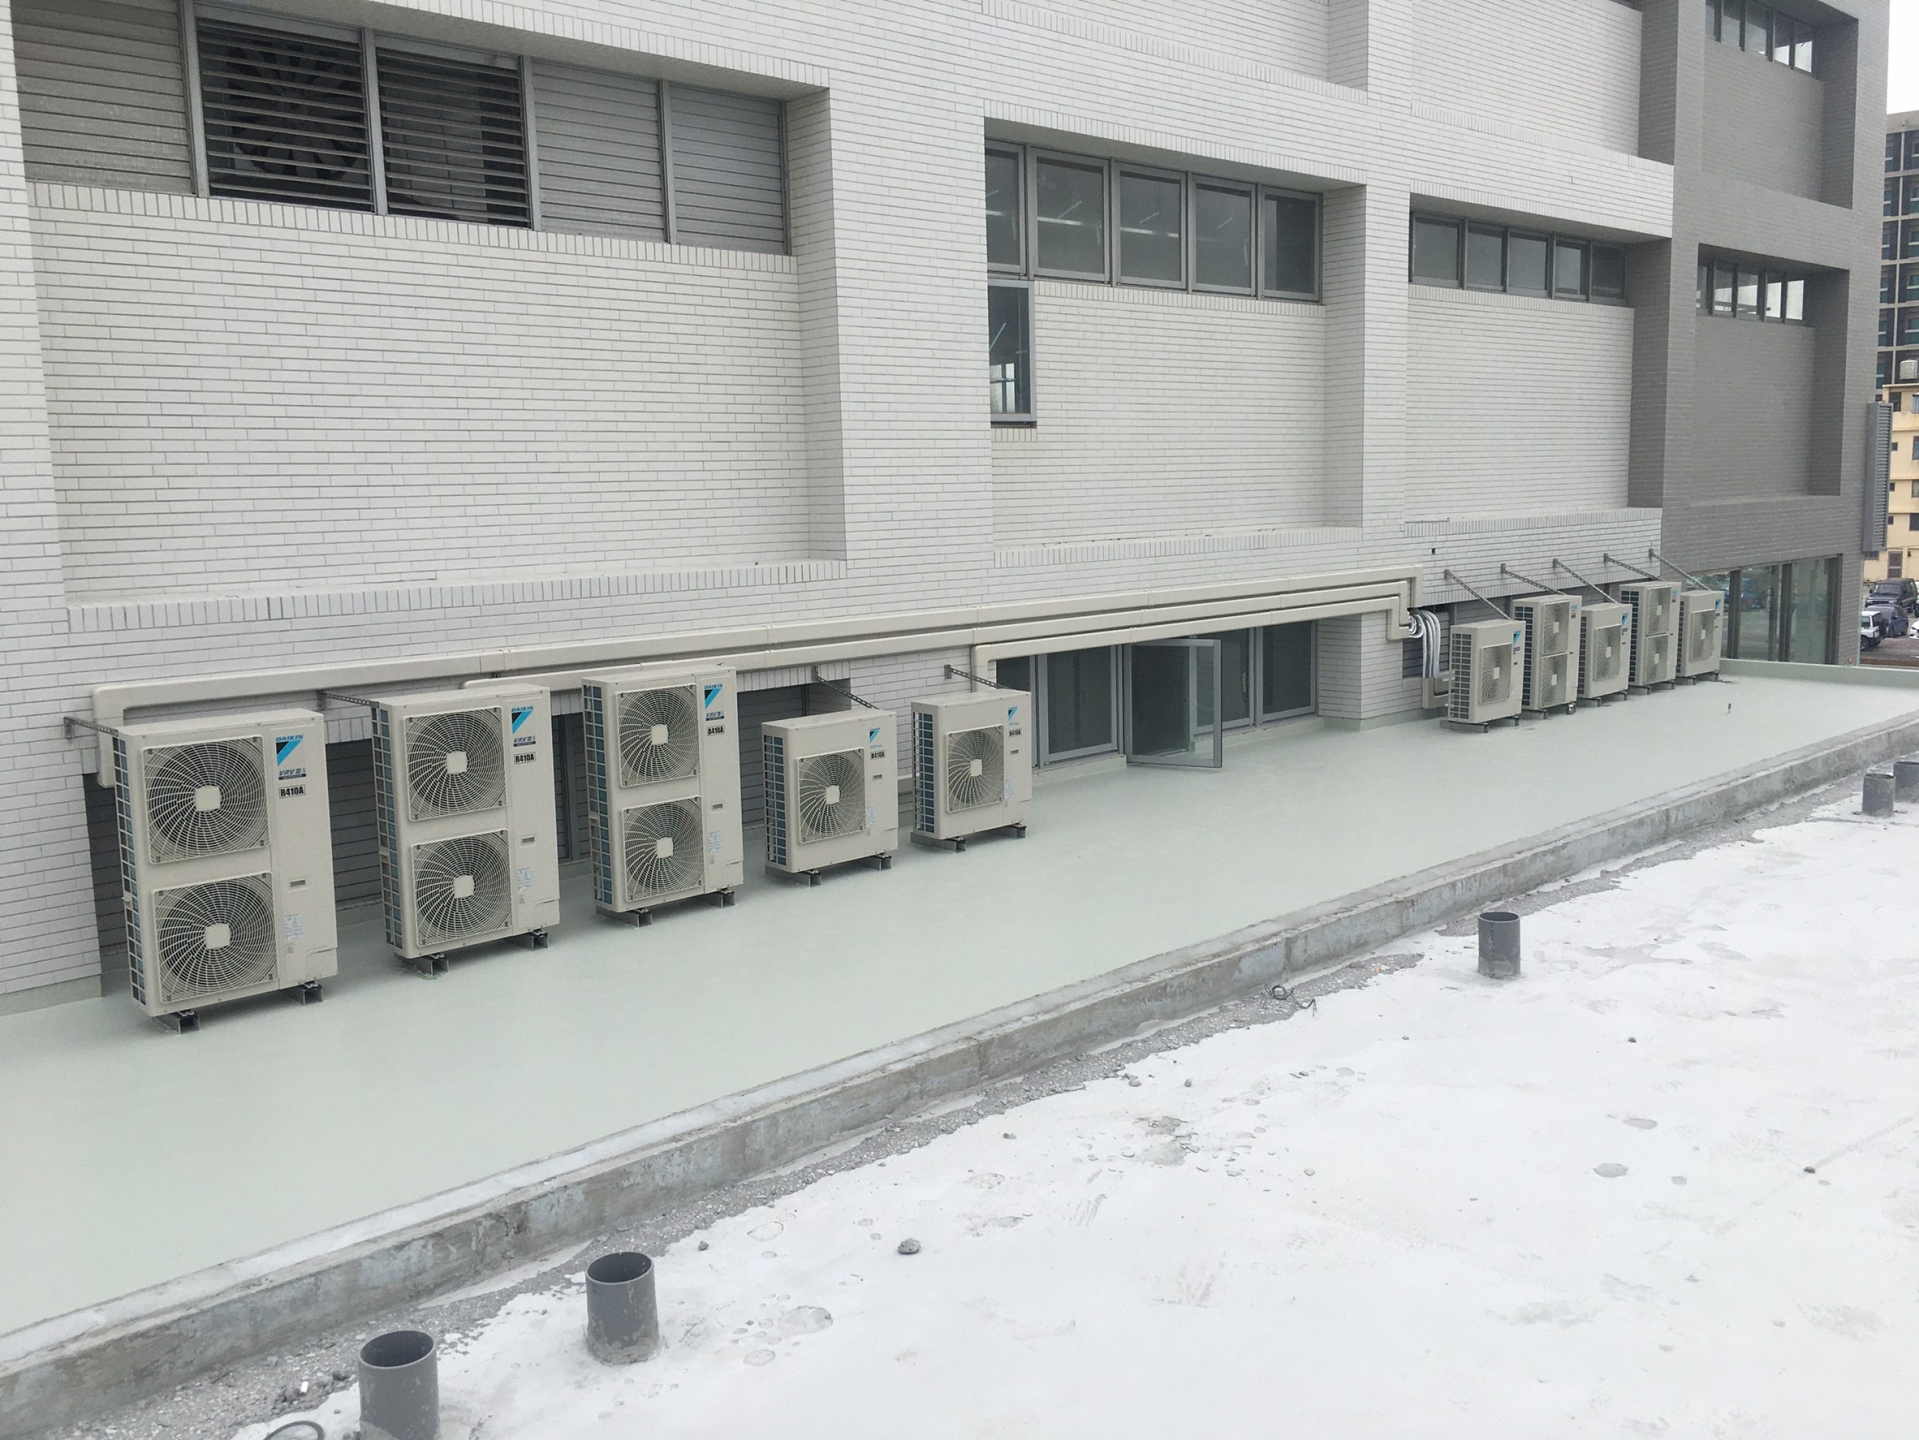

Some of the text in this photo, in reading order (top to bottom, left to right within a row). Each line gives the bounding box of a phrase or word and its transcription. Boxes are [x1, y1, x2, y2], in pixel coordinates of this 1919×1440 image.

[276, 734, 304, 742] DAIKIN
[515, 753, 535, 763] R410A
[279, 768, 296, 776] VRV
[280, 786, 304, 797] R410A
